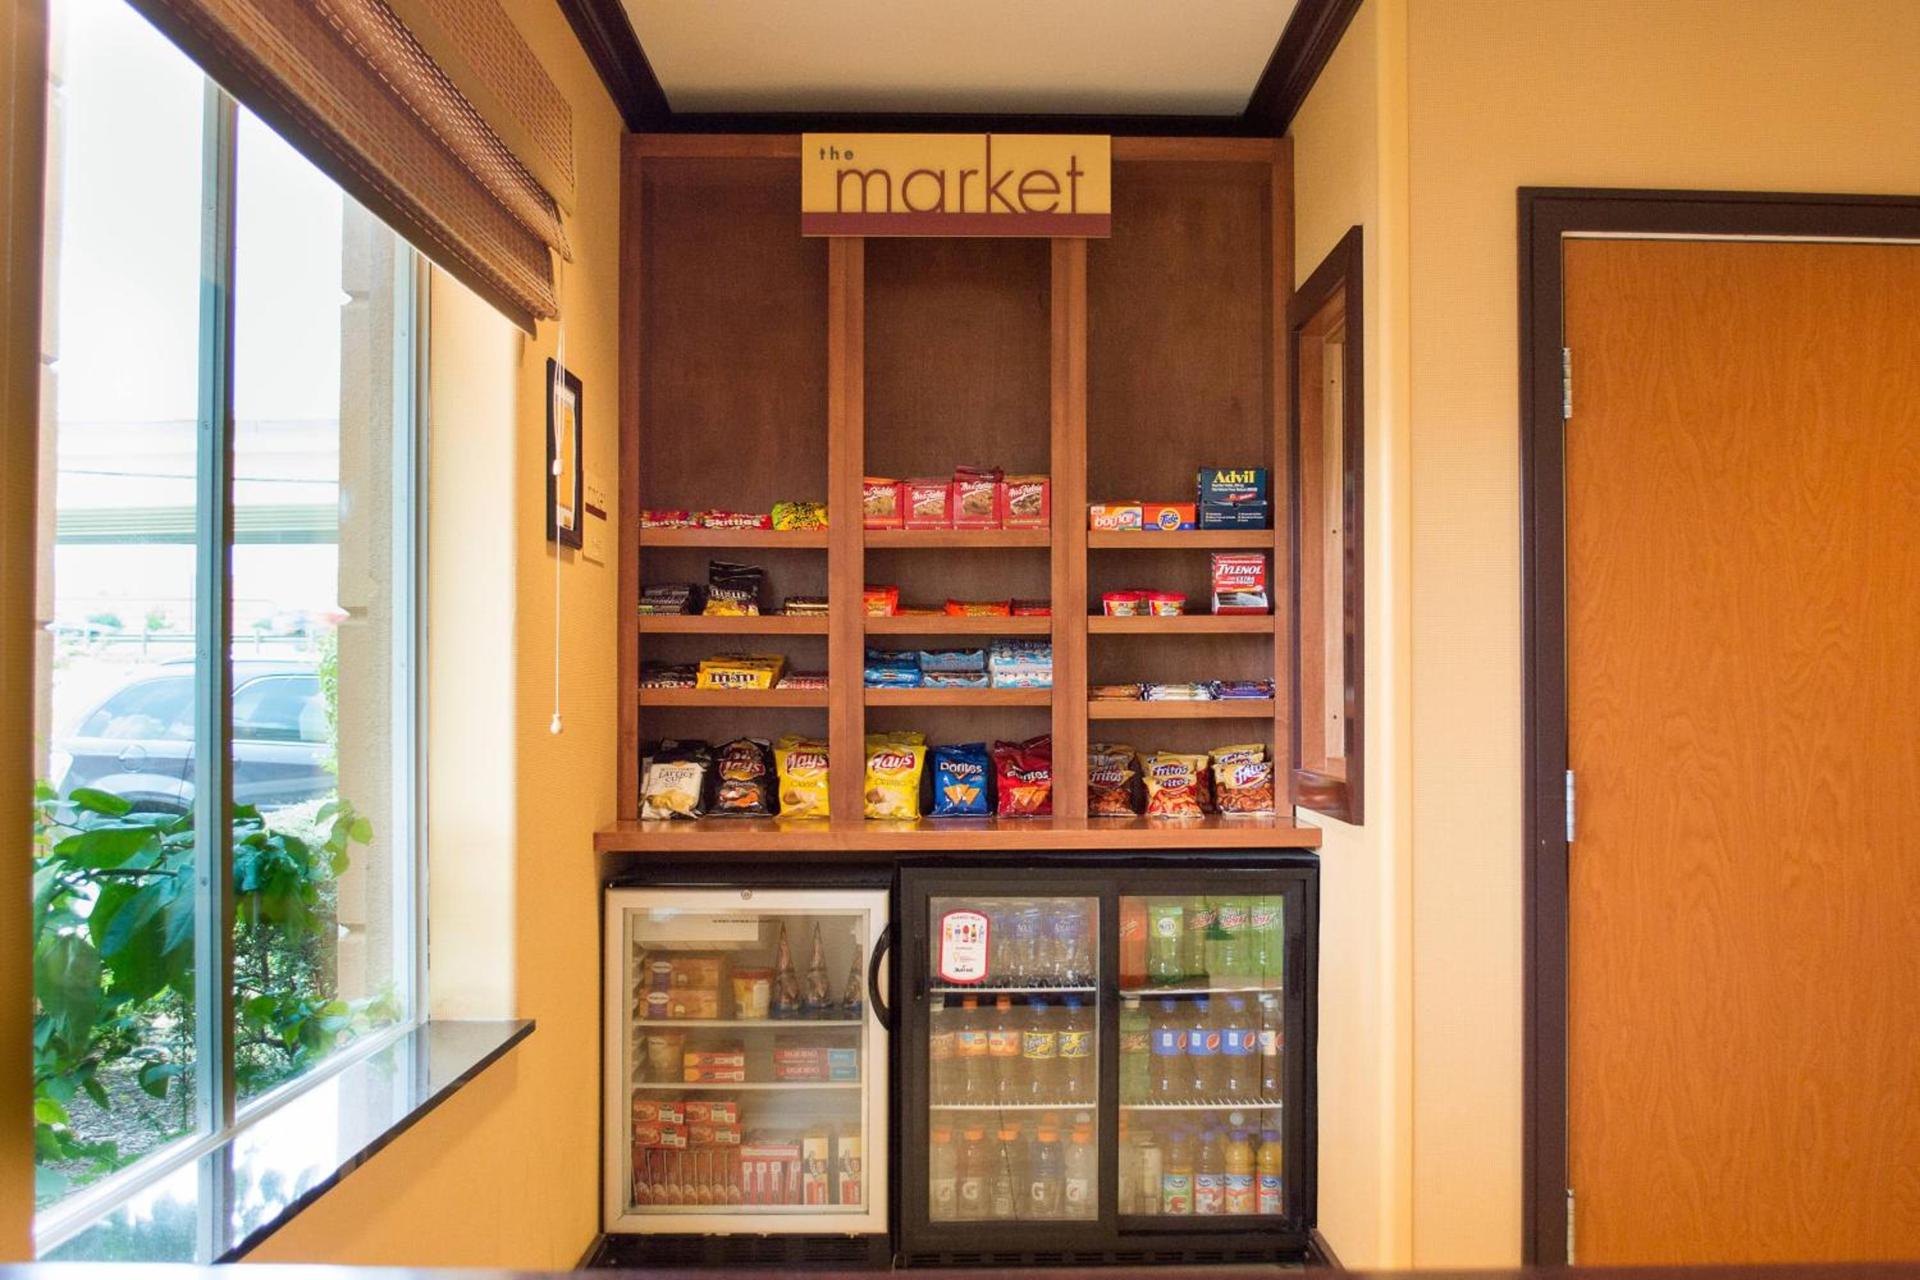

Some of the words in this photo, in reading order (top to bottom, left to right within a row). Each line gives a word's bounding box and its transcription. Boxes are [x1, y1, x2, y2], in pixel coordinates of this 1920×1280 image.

[818, 146, 855, 161] the
[836, 132, 1085, 214] market
[1212, 470, 1256, 484] Advil
[704, 518, 762, 528] Skittles
[1159, 513, 1179, 527] Tide
[1215, 564, 1263, 577] TYLENOL
[940, 762, 983, 775] Doritos
